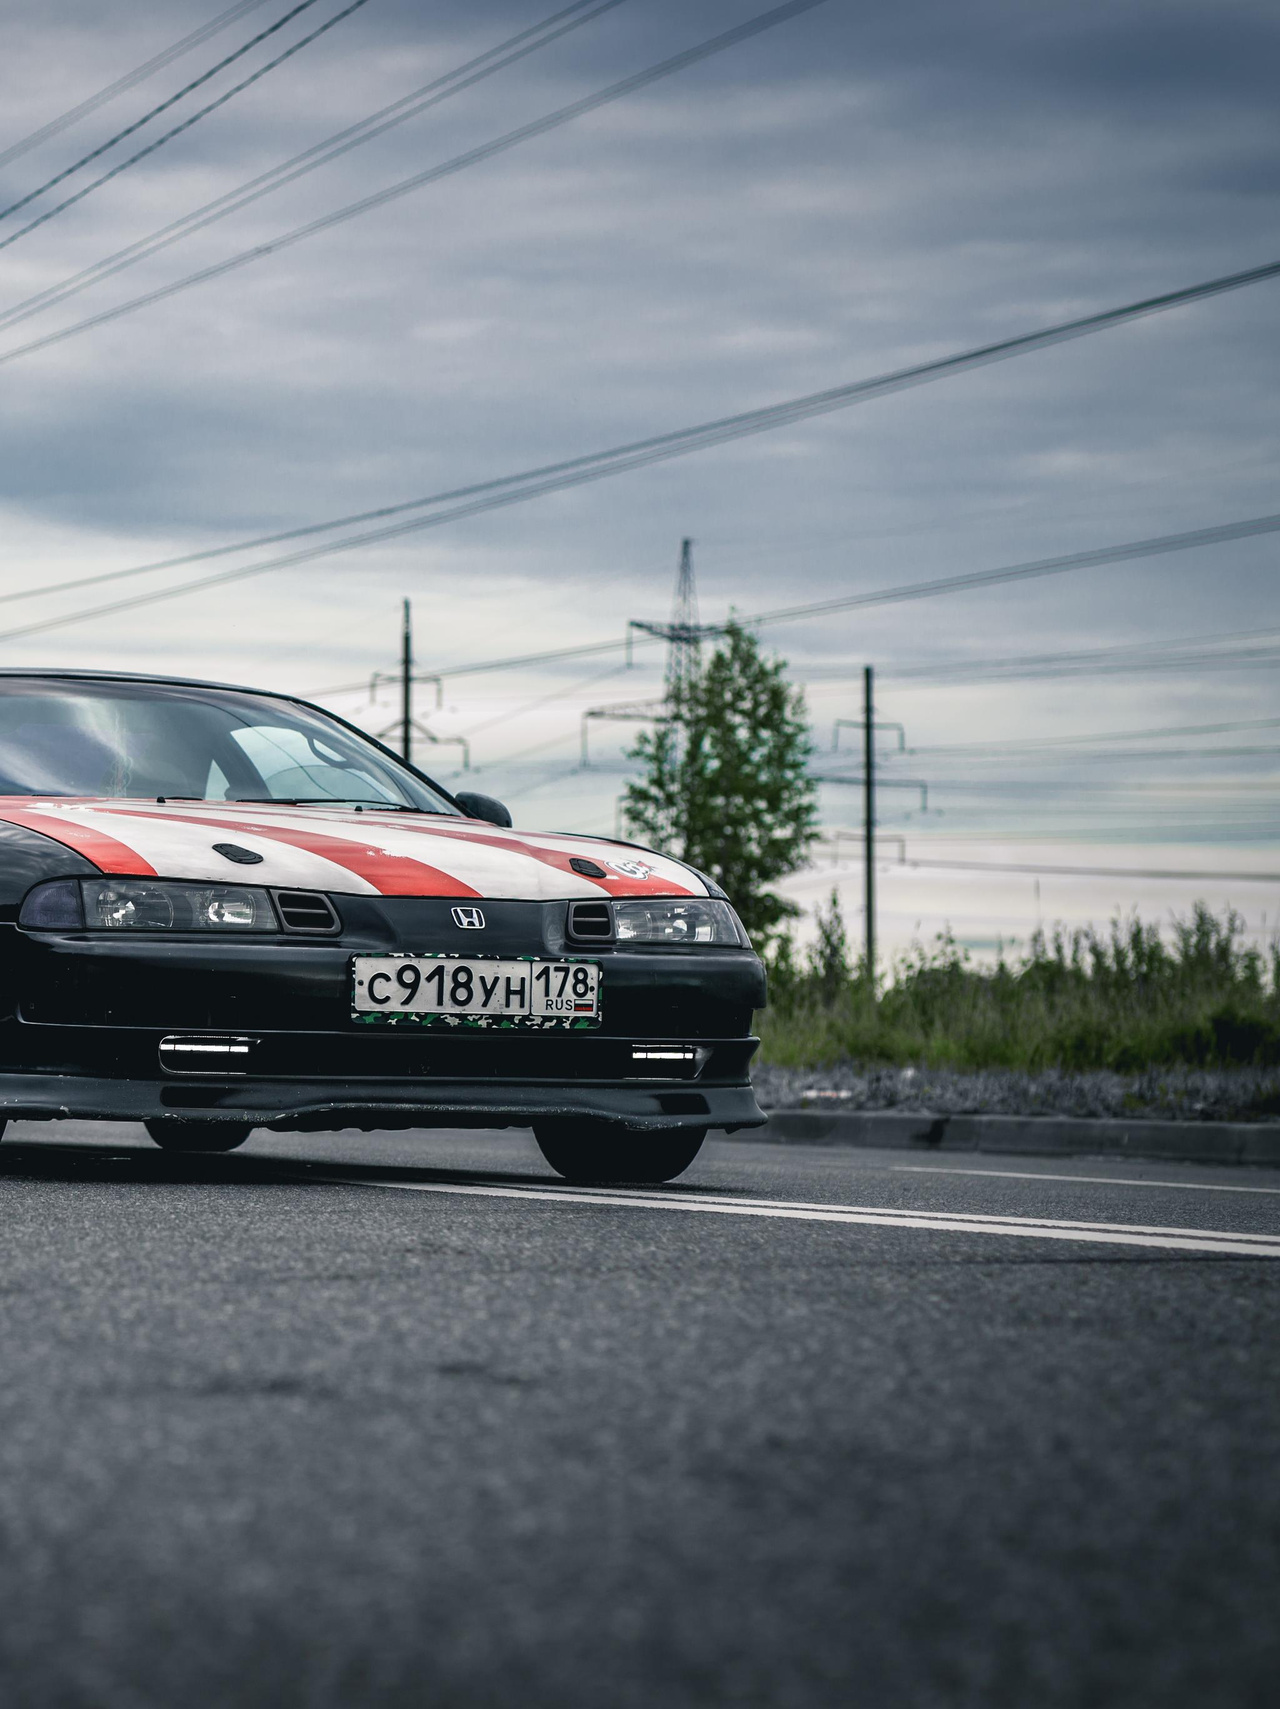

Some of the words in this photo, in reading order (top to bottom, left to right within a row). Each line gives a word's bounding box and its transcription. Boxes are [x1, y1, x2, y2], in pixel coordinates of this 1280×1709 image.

[368, 964, 526, 1008] С918УН
[535, 966, 589, 998] 178
[545, 999, 573, 1011] RUS
